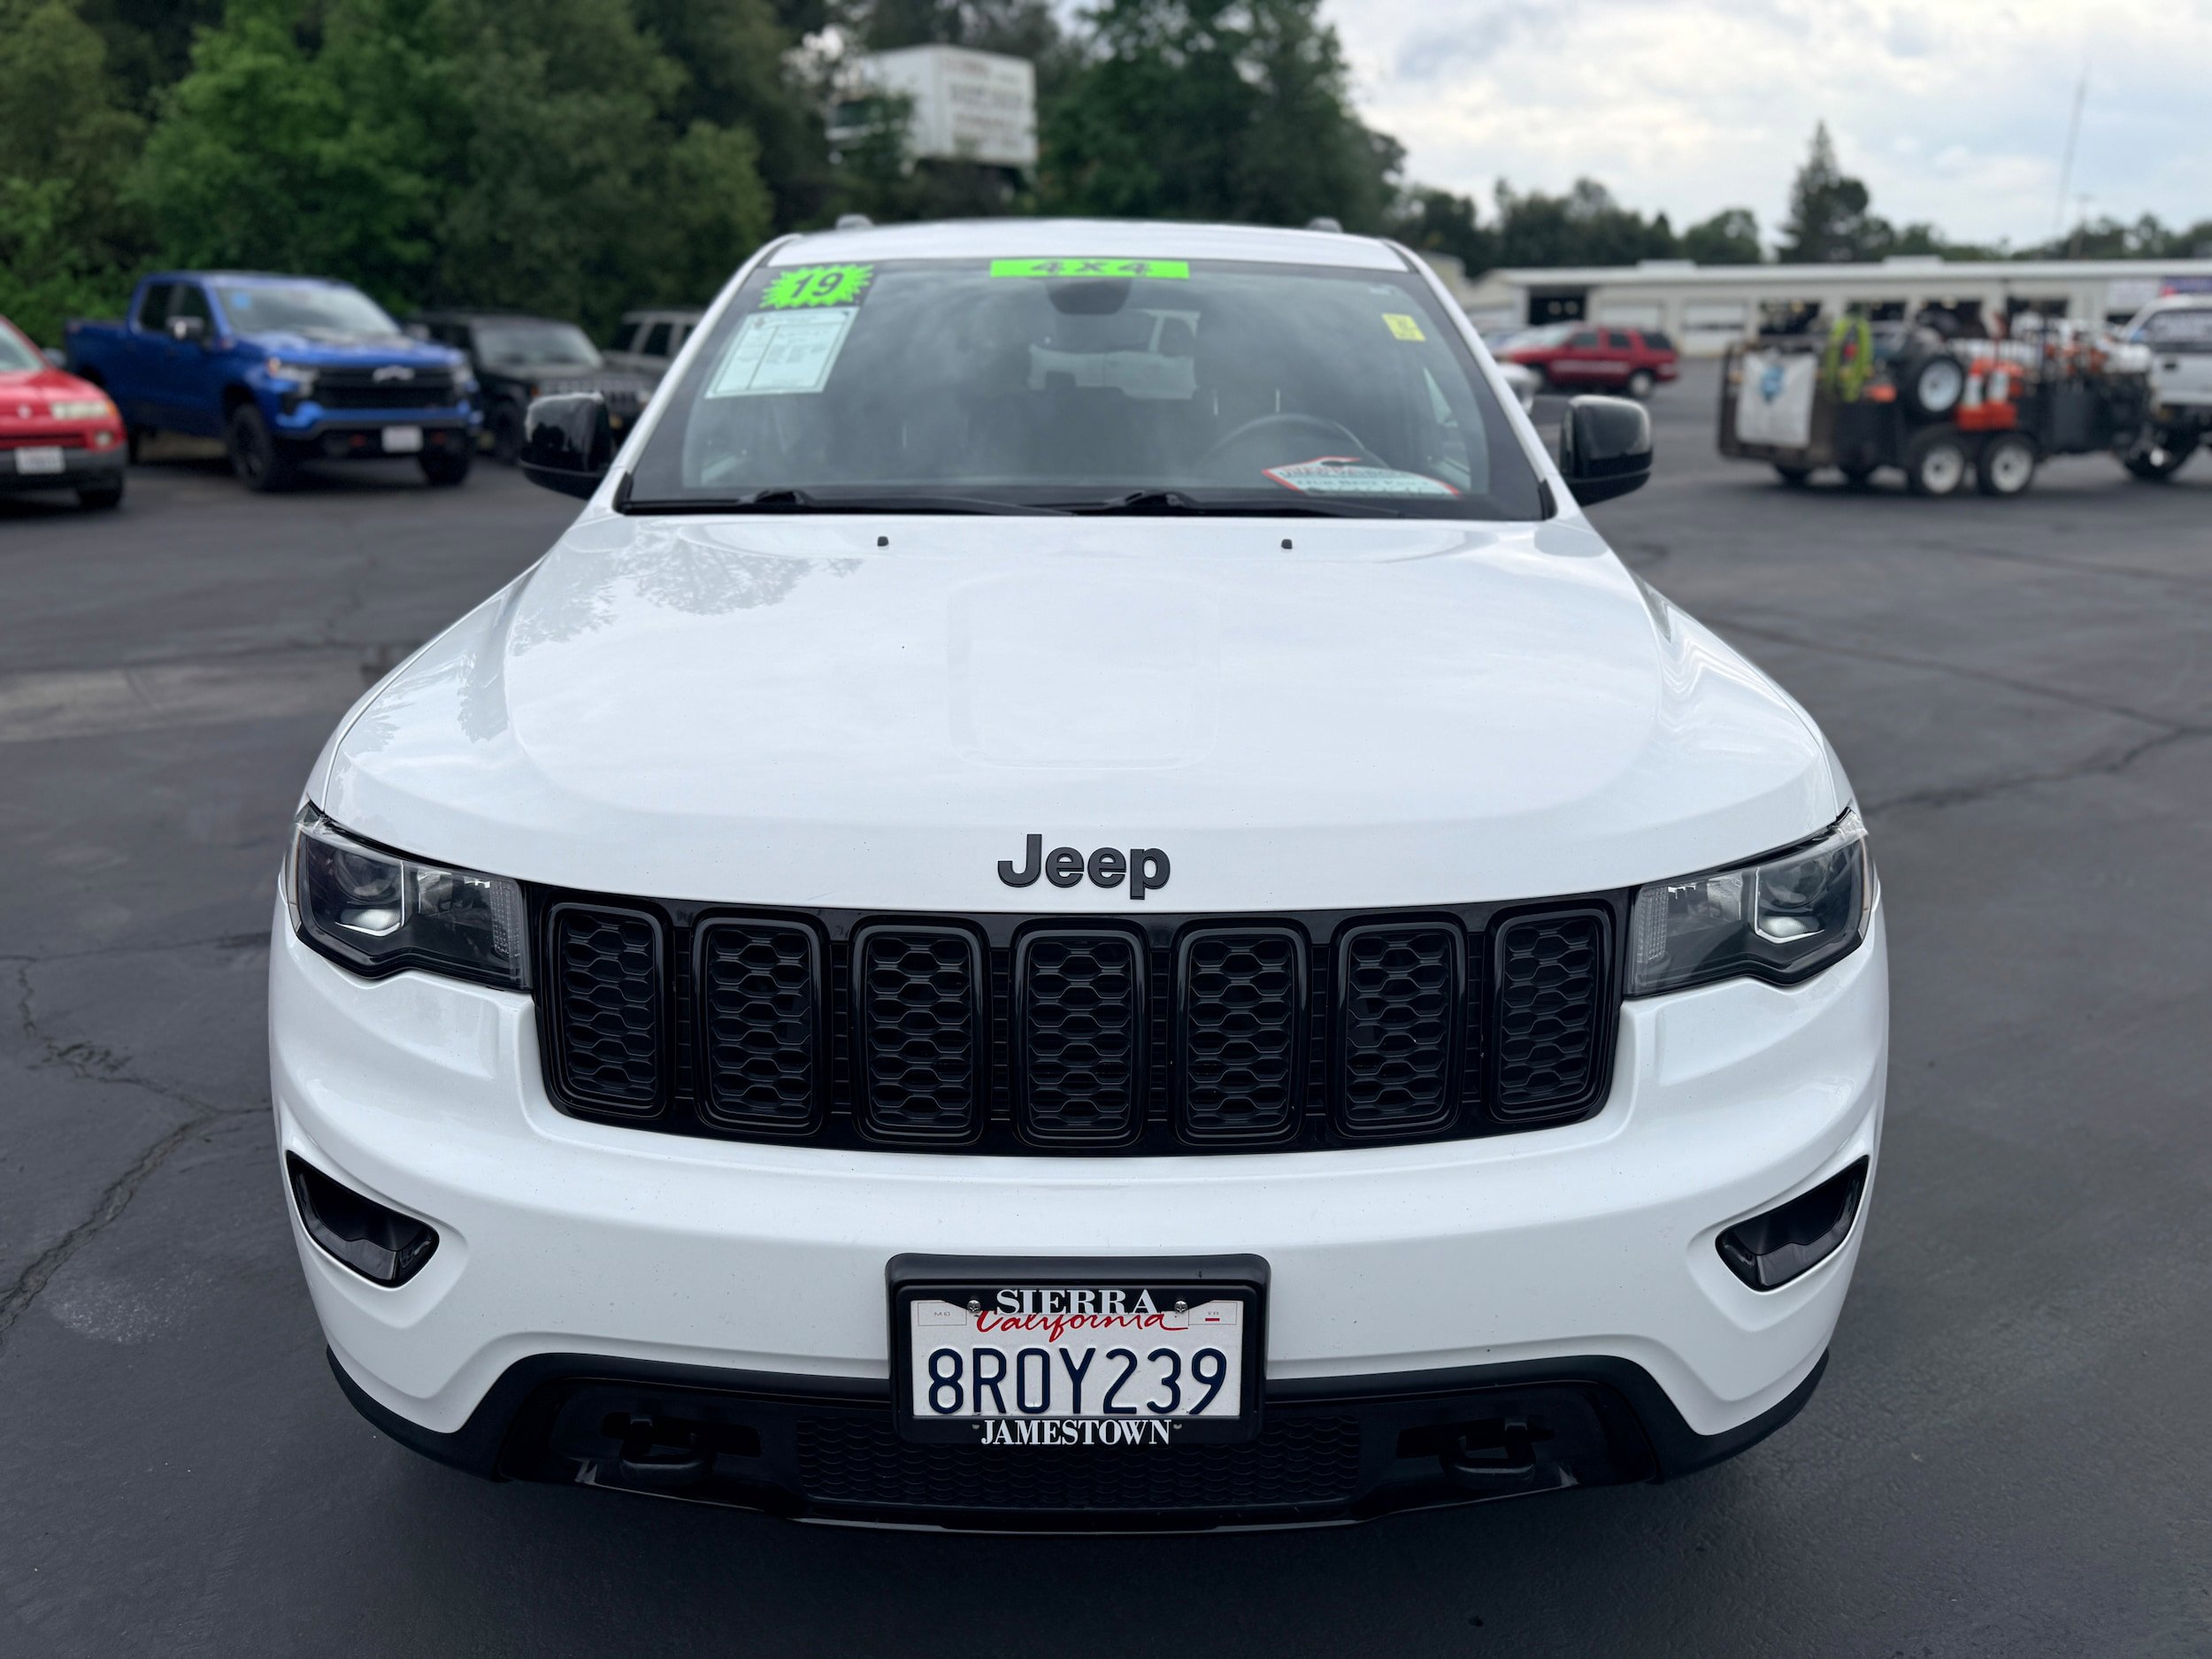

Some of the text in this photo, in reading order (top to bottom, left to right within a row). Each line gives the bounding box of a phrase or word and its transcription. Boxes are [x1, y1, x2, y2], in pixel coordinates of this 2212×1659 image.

[791, 272, 844, 299] 19
[997, 833, 1171, 901] Jeep
[996, 1288, 1157, 1315] SIERRA
[981, 1419, 1172, 1445] JAMESTOWN
